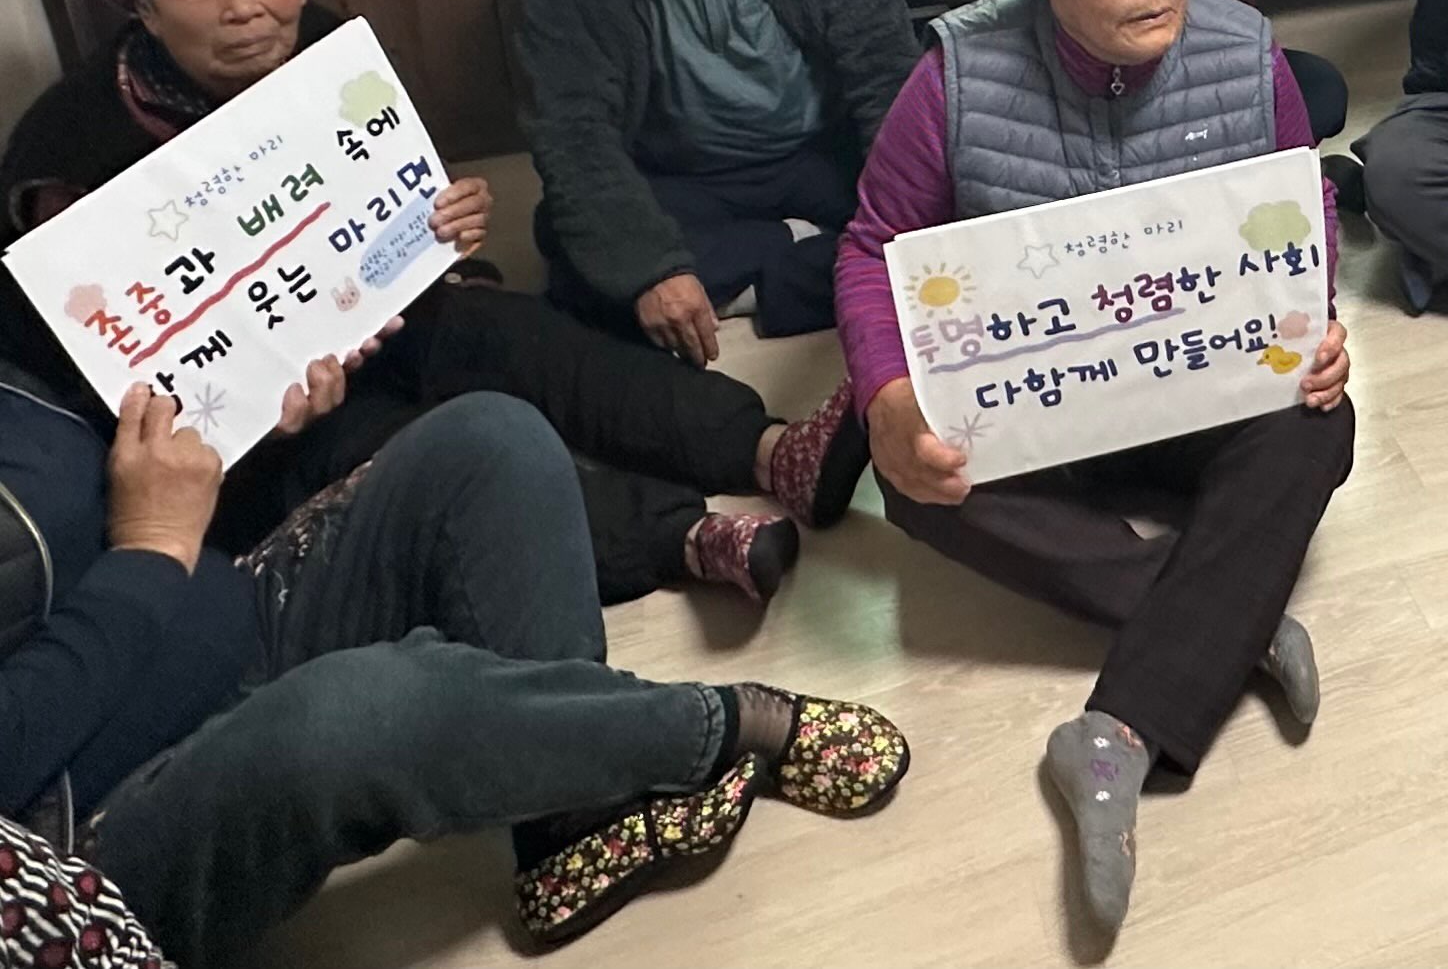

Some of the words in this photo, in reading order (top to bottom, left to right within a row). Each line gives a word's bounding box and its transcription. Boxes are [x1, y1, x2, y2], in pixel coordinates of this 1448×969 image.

[249, 135, 283, 161] 마리
[85, 247, 216, 356] 존중과
[237, 163, 324, 237] 배려
[336, 105, 401, 161] 속에
[248, 264, 318, 330] 웃는
[328, 156, 437, 253] 마리면
[1144, 220, 1184, 236] 마리
[910, 297, 1076, 364] 투명하고
[1091, 265, 1222, 323] 청렴한
[1239, 242, 1319, 277] 사회
[976, 358, 1118, 408] 다함께
[1133, 313, 1278, 379] 만들어요!
